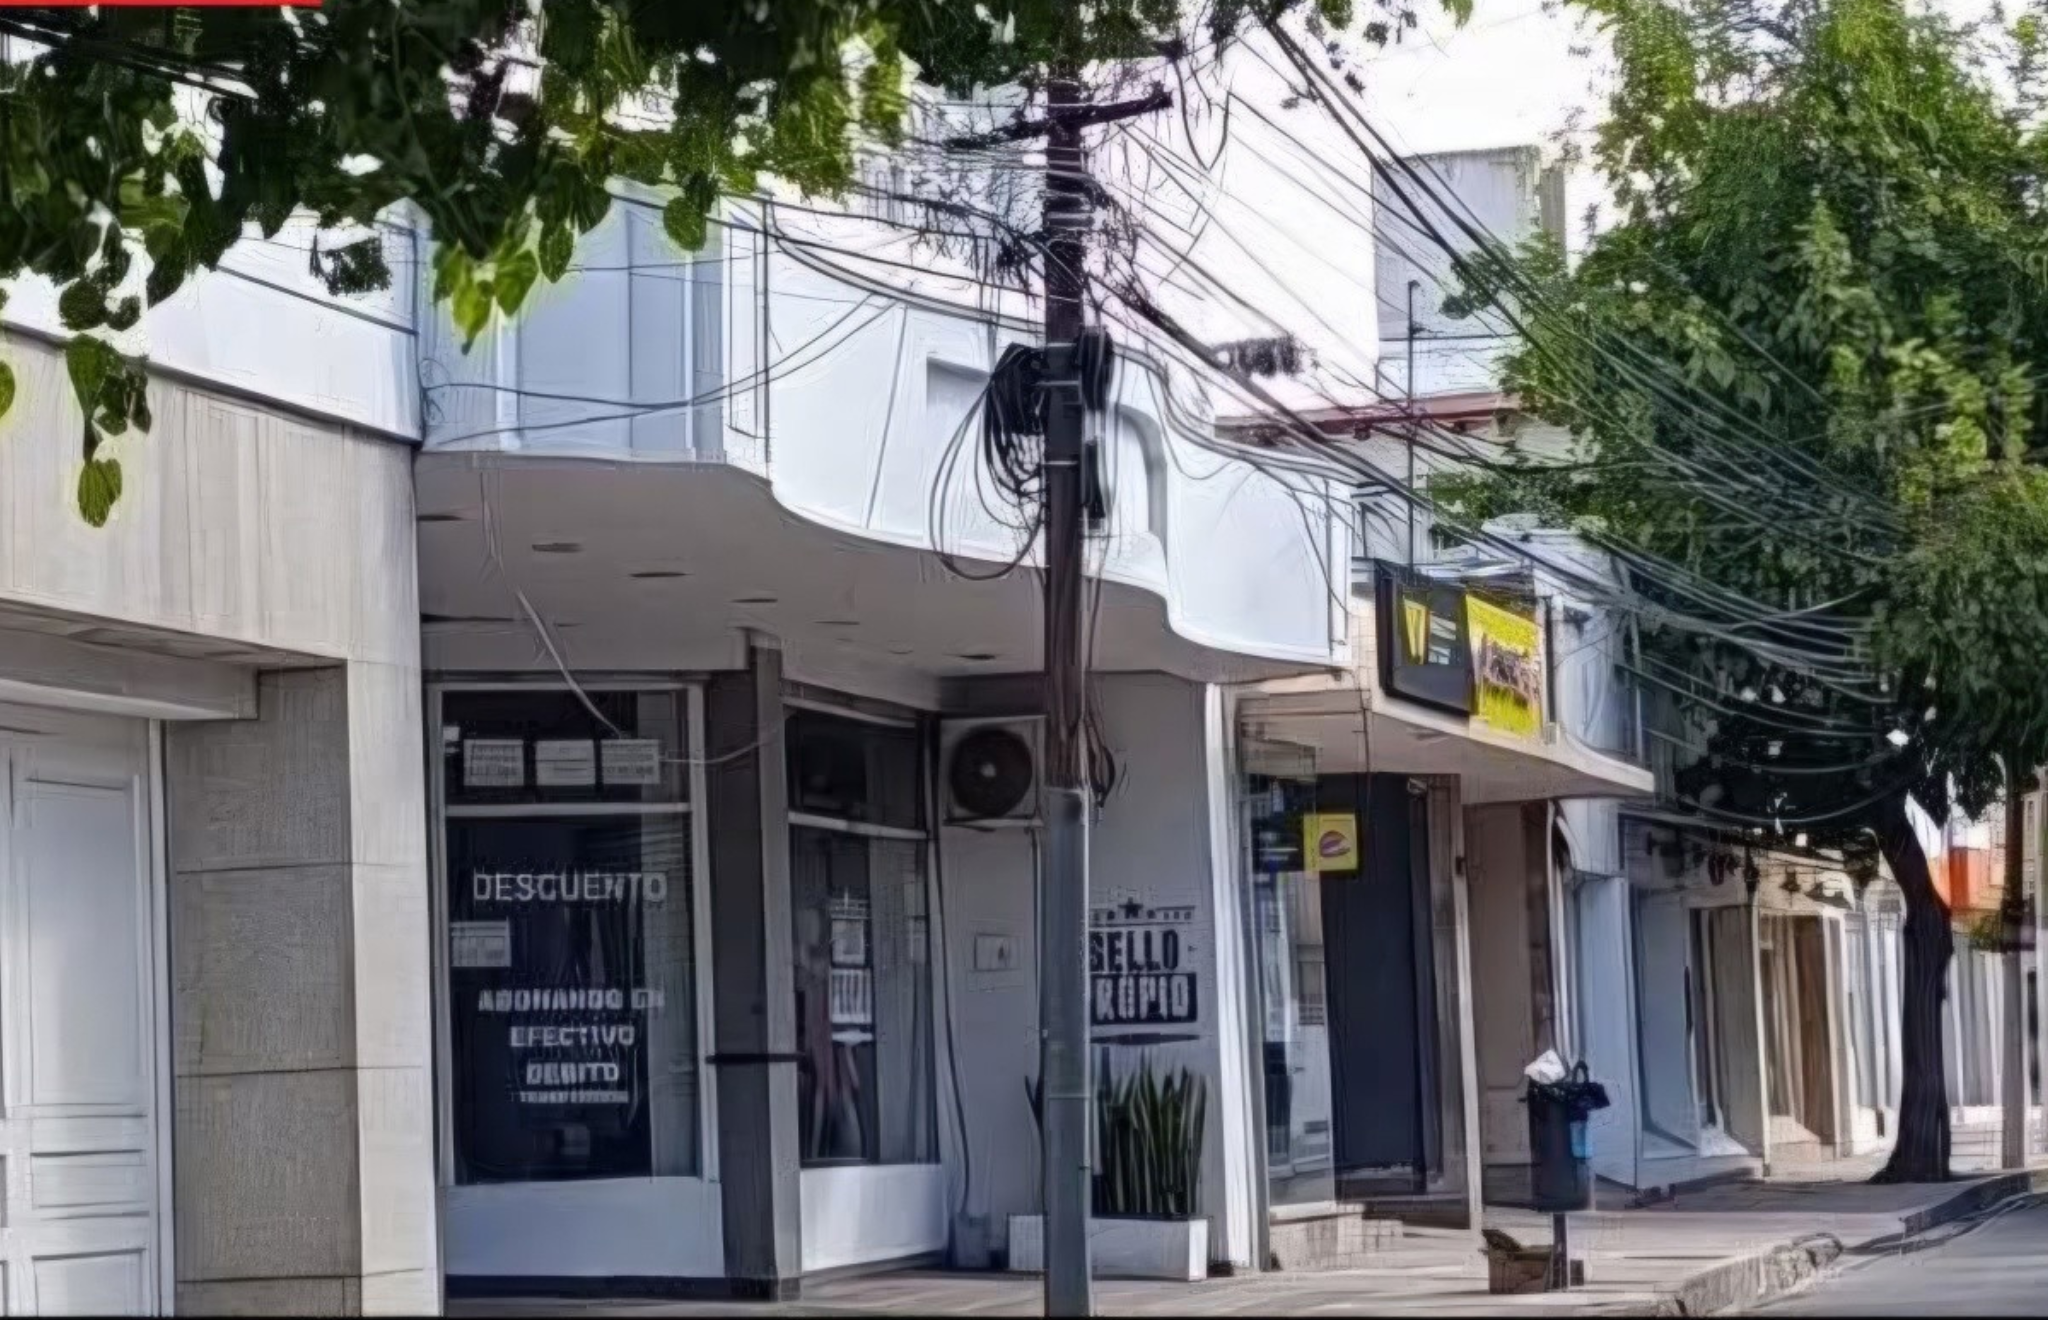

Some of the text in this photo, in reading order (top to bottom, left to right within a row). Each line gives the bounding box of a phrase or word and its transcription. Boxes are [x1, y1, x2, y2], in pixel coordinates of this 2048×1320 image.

[474, 873, 667, 902] DESCUENTO
[1088, 929, 1179, 972] SELLO
[510, 1026, 635, 1047] EFECTIVO
